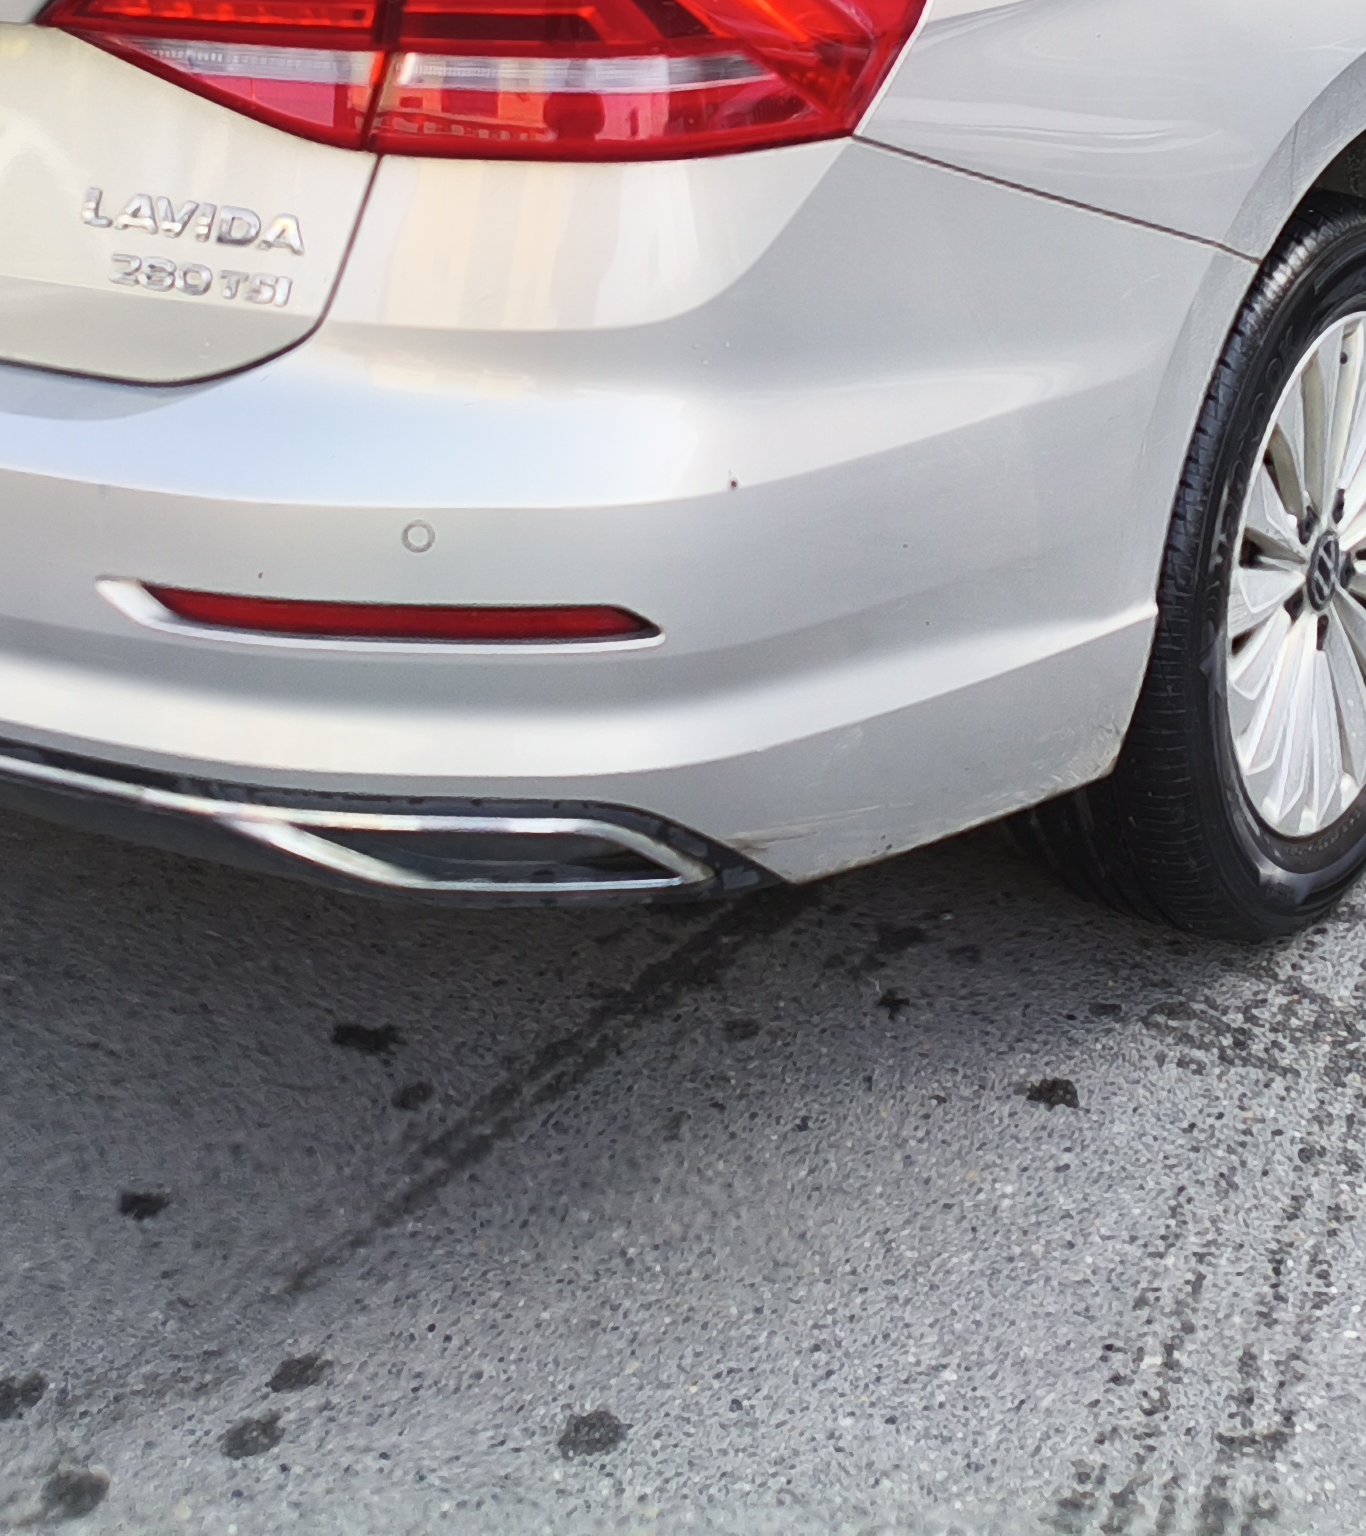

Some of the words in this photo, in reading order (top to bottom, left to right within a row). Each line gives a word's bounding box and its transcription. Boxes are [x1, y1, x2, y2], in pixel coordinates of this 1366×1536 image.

[81, 186, 306, 256] LAVIDA
[108, 253, 213, 296] 280
[220, 269, 294, 307] TSI
